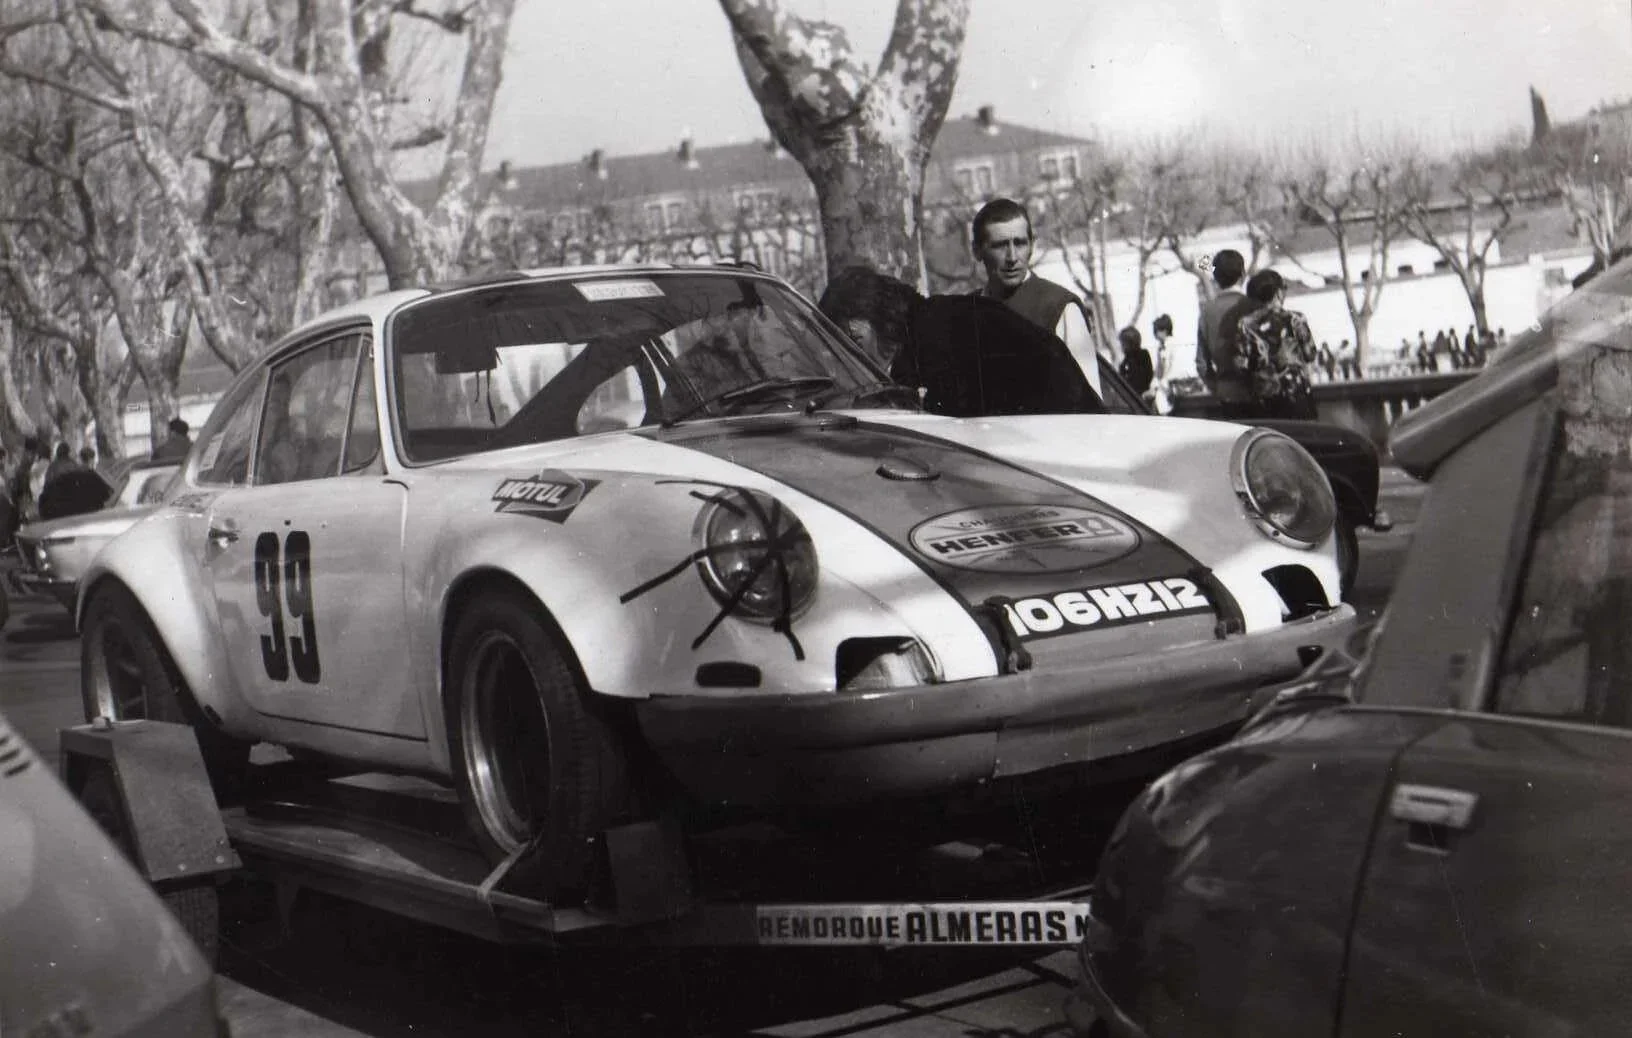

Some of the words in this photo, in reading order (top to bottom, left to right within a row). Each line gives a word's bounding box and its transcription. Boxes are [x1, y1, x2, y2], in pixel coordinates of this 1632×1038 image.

[495, 481, 568, 504] MOTUL
[255, 531, 321, 684] 99
[1003, 578, 1209, 636] 106HZ12
[759, 916, 901, 938] REMORQUE
[905, 911, 1068, 942] ALMERAS
